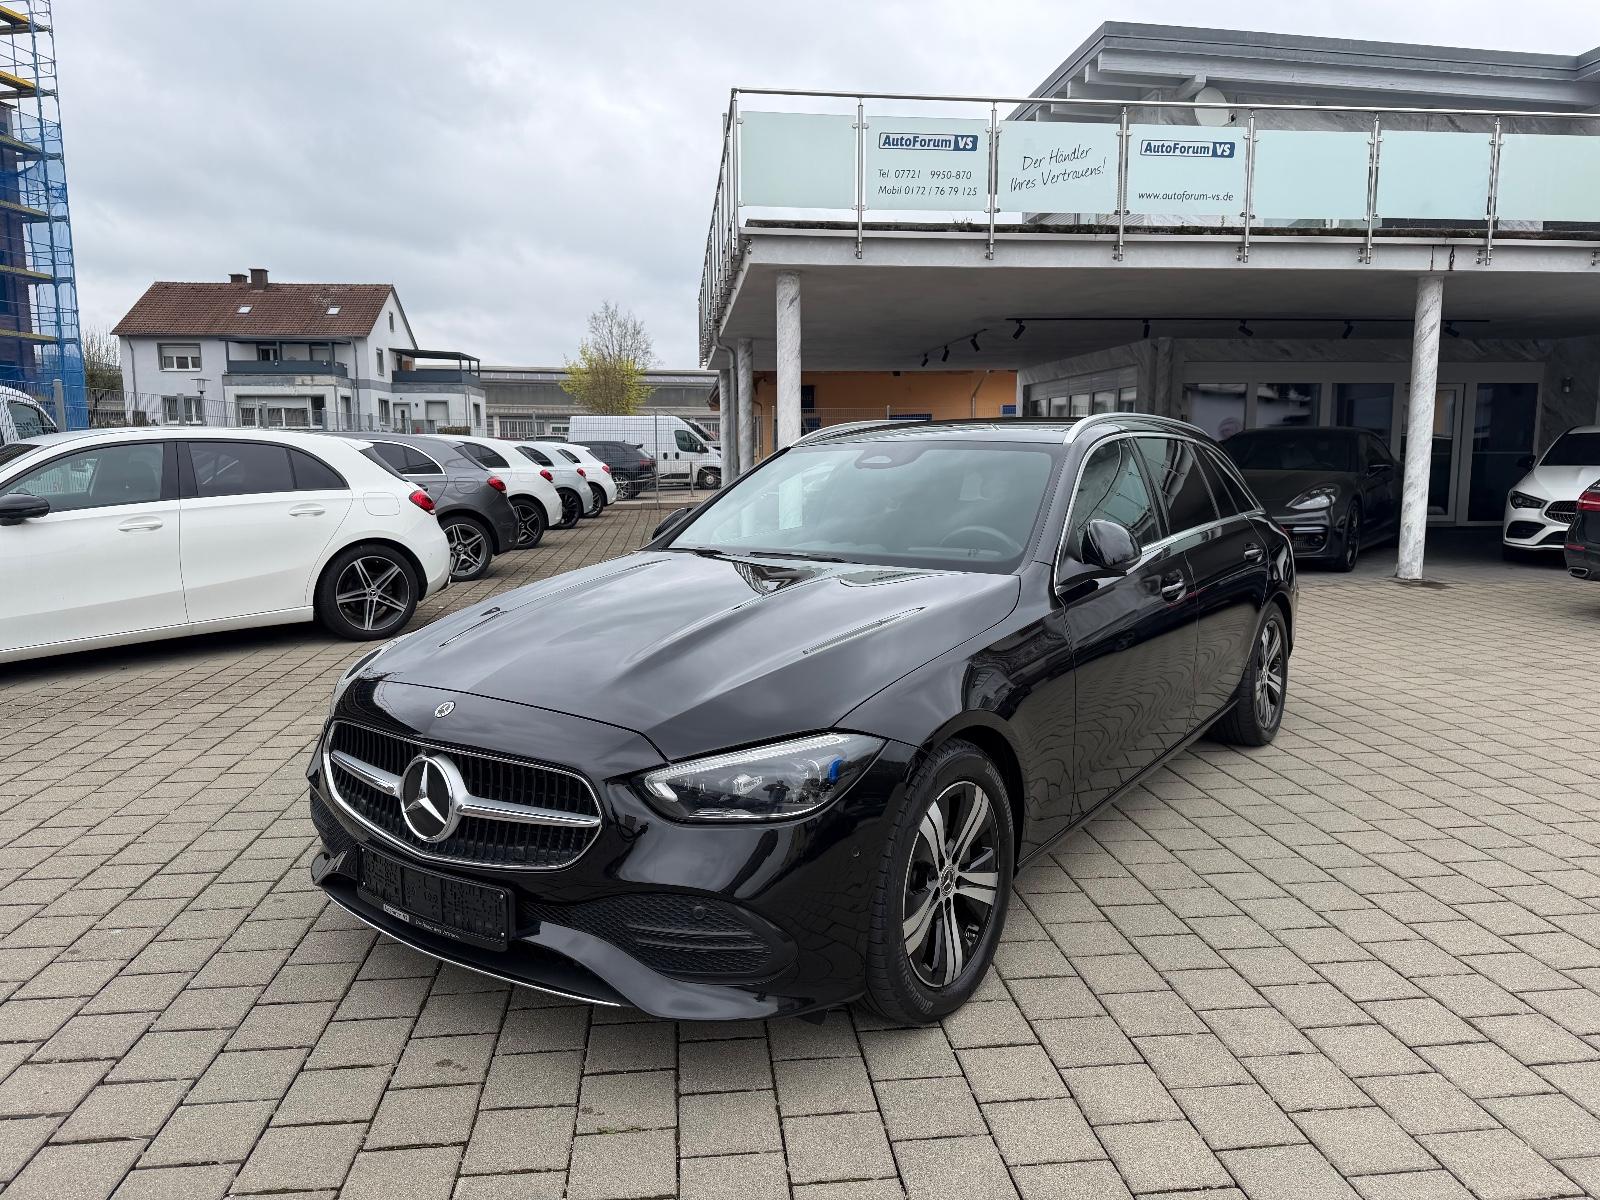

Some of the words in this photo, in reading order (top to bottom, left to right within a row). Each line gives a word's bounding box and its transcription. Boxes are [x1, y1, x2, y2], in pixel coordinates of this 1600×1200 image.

[882, 134, 952, 149] AutoForum
[957, 136, 974, 149] VS
[1144, 141, 1210, 155] AutoForum
[1215, 143, 1231, 156] VS
[1022, 155, 1047, 171] Der
[1049, 143, 1092, 165] Händler
[894, 169, 921, 179] 07721
[930, 170, 972, 180] 9950-870
[1010, 176, 1037, 193] Ihres
[1041, 156, 1107, 186] Vertrauens!
[878, 185, 902, 195] Mobil
[904, 185, 926, 195] 0172
[935, 186, 946, 196] 76
[948, 186, 959, 196] 79
[962, 186, 978, 196] 125
[1138, 191, 1234, 203] www.autoforum-vs.de
